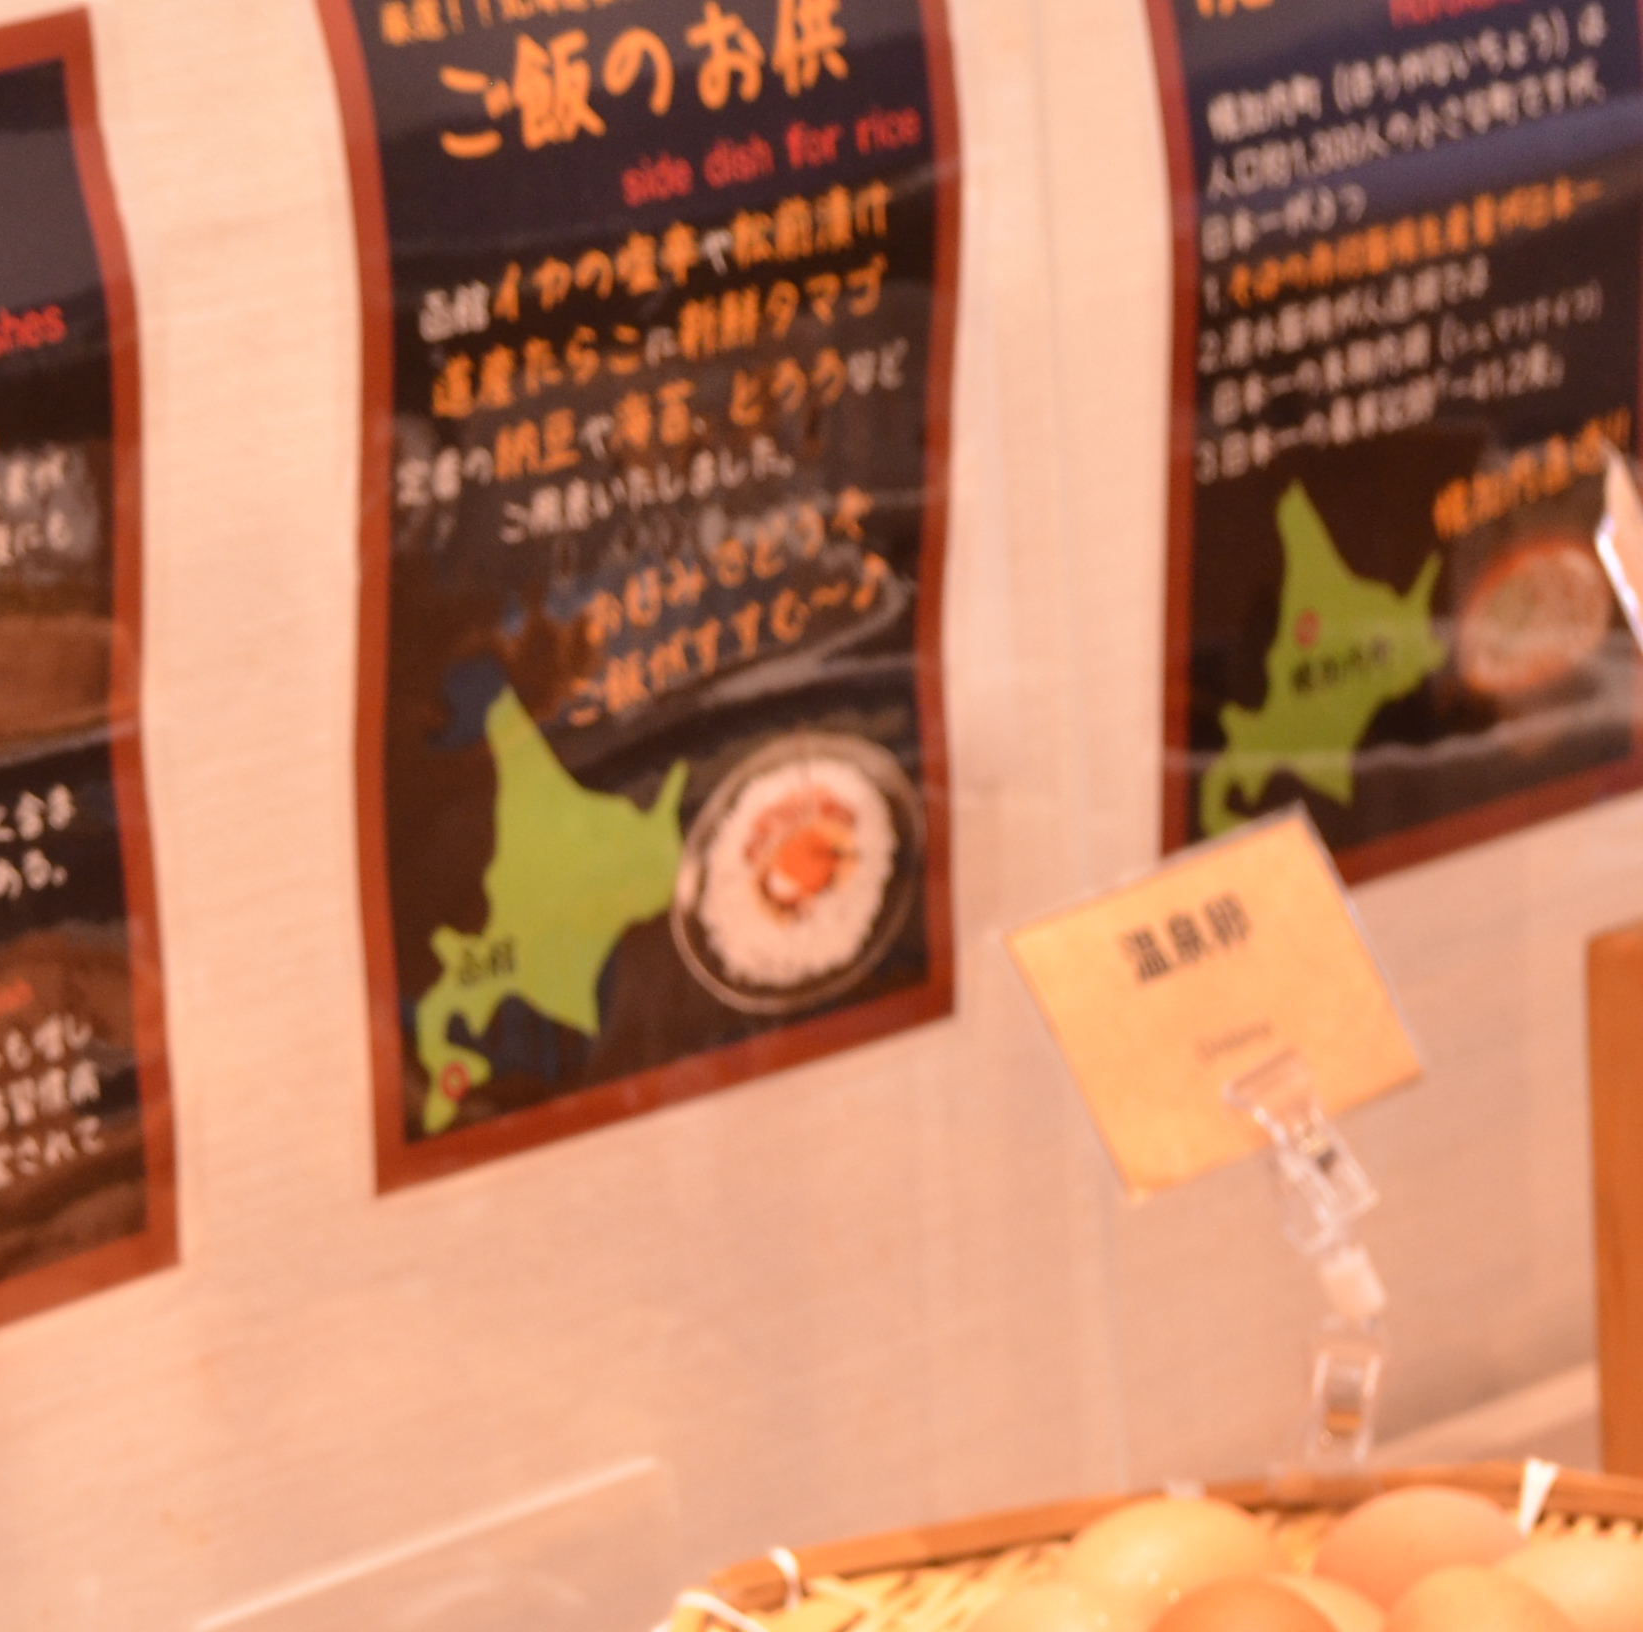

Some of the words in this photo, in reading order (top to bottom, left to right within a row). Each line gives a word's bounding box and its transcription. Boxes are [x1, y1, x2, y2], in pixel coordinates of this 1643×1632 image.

[622, 152, 694, 207] side
[786, 120, 843, 169] for
[855, 106, 921, 155] rice
